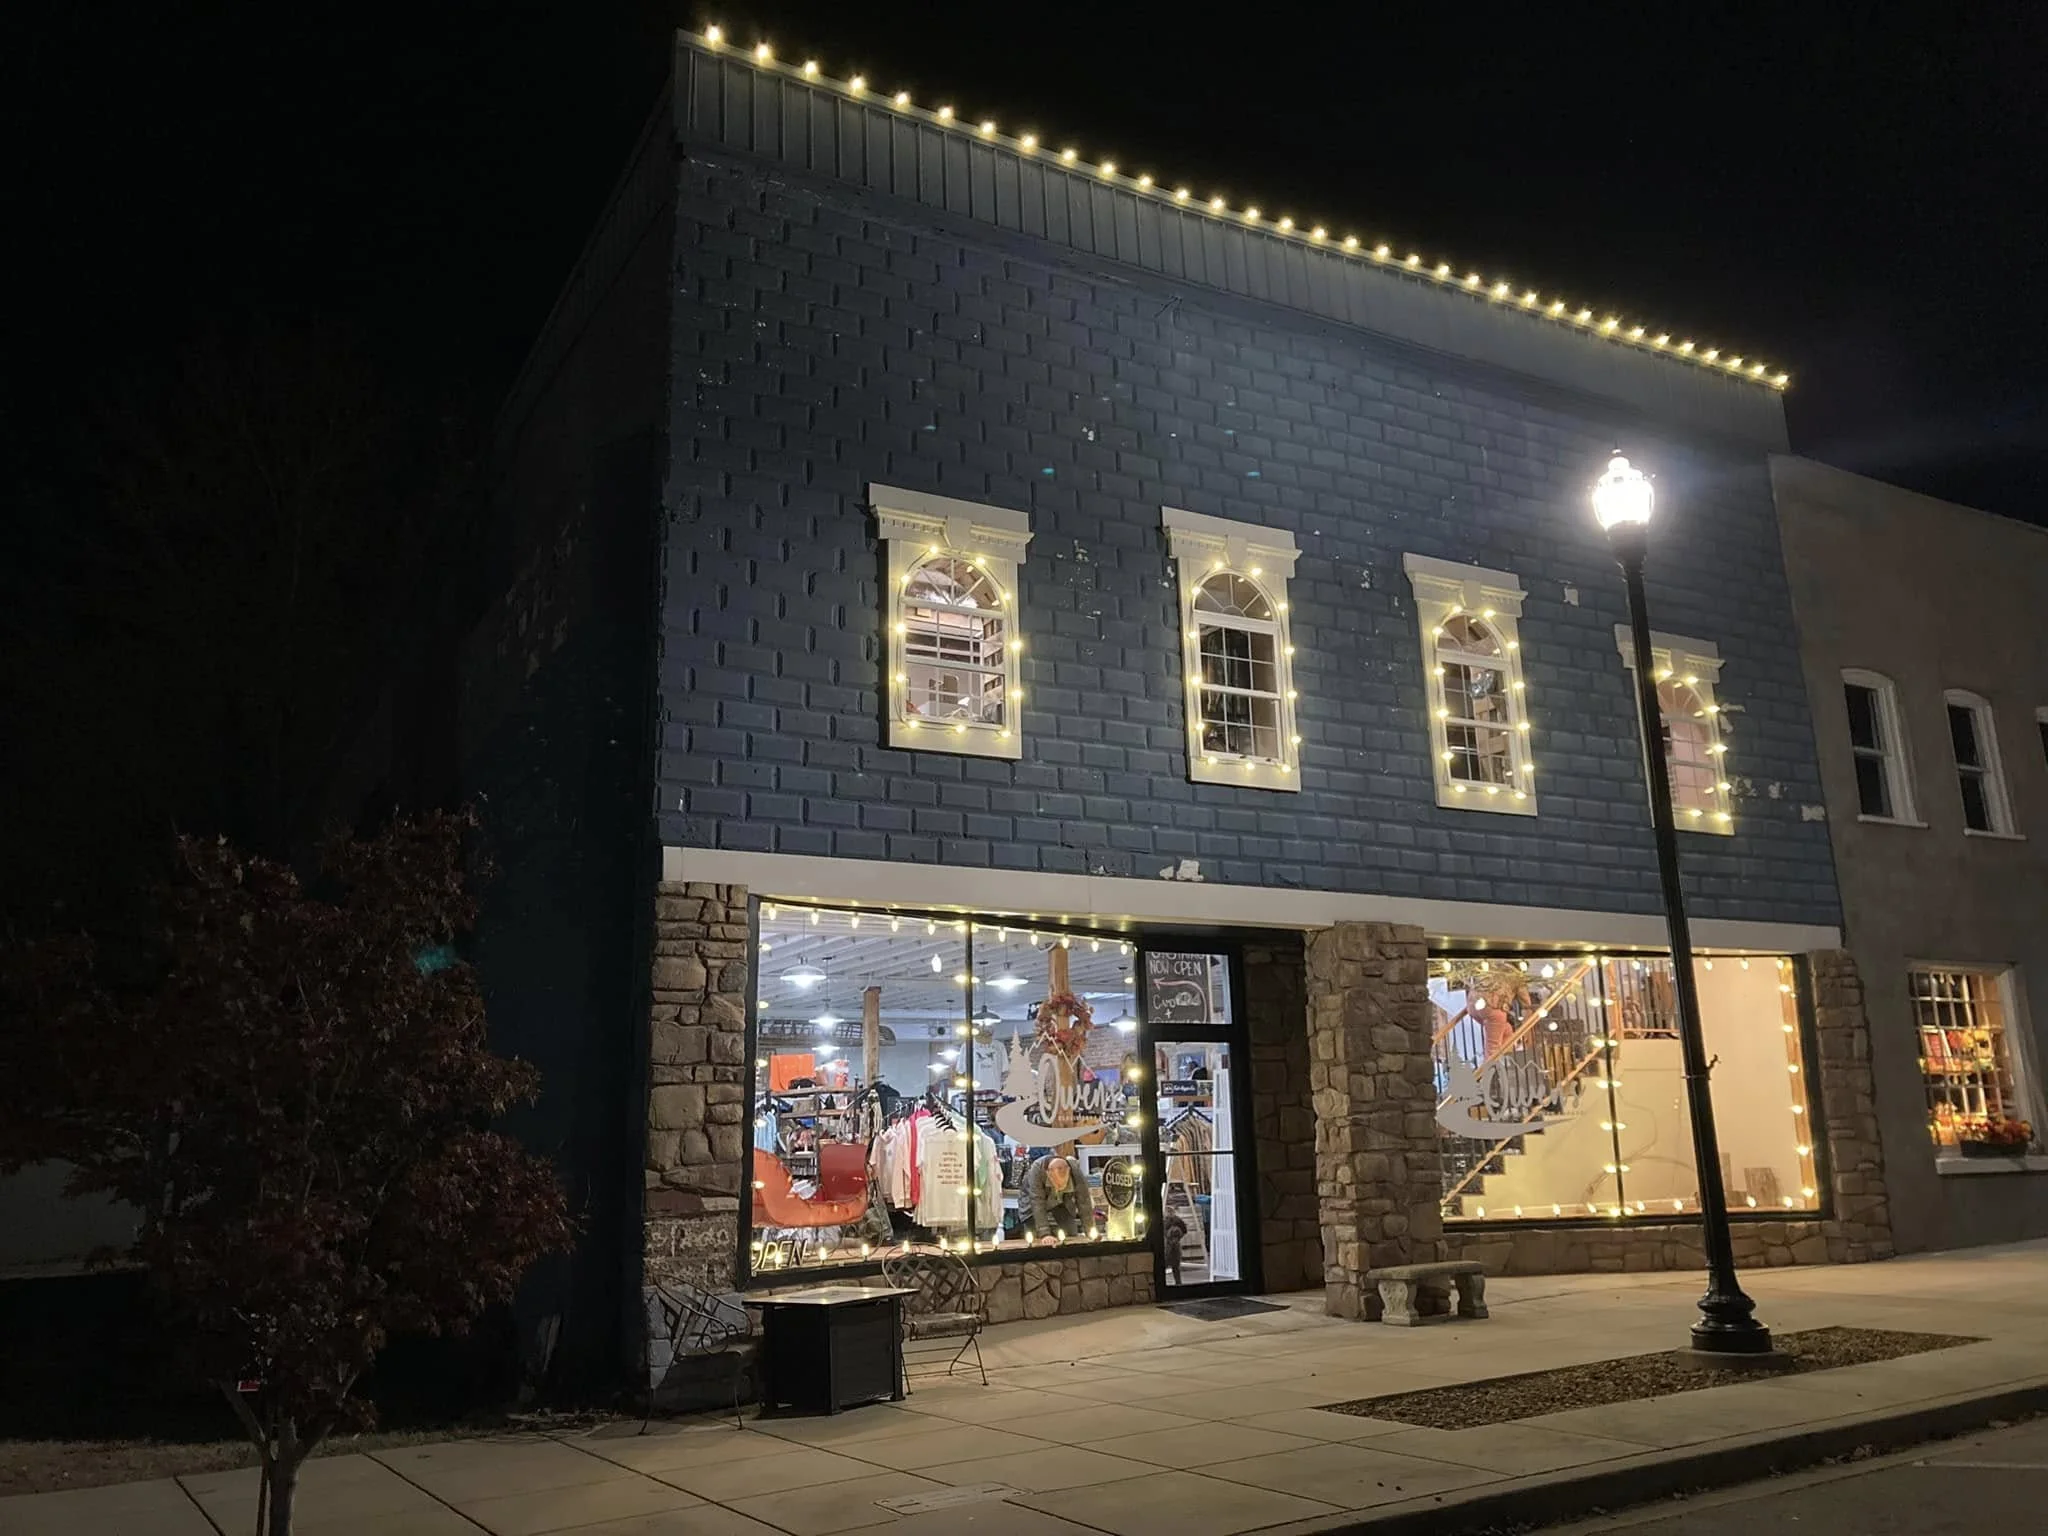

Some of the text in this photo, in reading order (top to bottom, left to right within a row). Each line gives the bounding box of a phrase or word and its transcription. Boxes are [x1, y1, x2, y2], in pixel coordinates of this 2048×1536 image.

[1149, 960, 1202, 976] NOW OPEN
[1105, 1172, 1133, 1188] CLOSED
